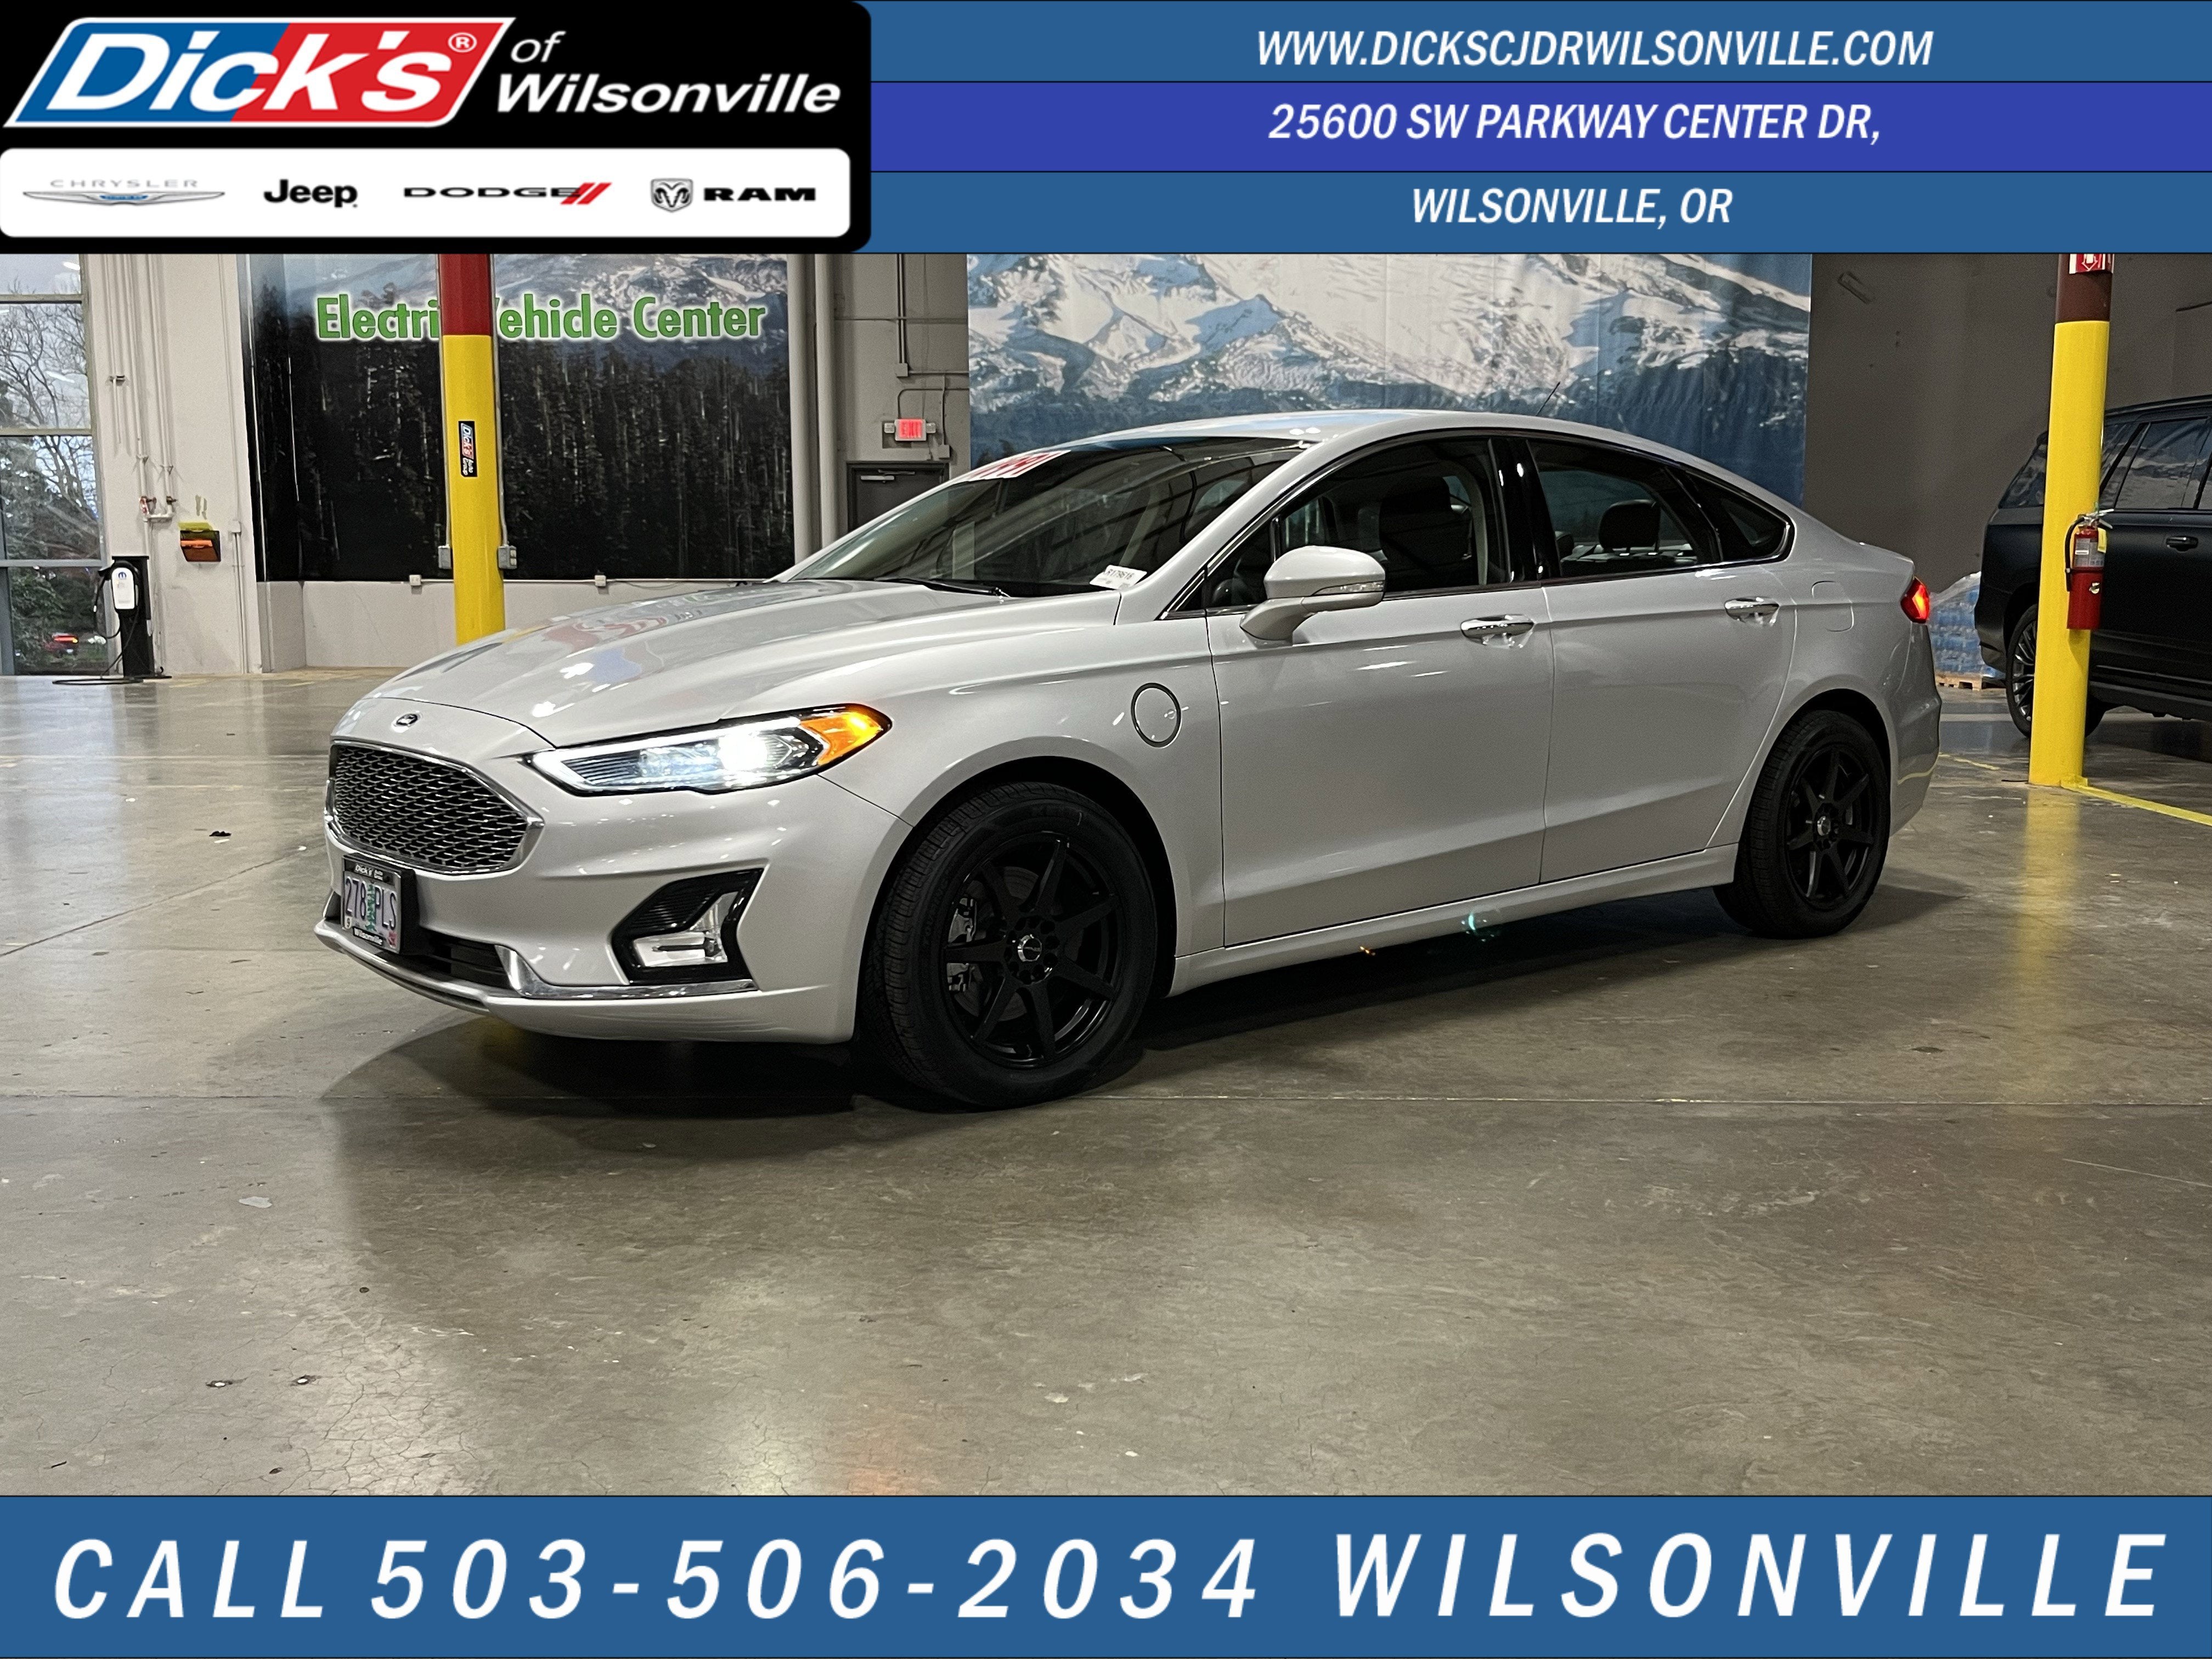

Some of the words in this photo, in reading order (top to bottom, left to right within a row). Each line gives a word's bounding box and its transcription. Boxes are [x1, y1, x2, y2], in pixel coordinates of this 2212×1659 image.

[317, 294, 438, 338] Electri
[495, 294, 617, 338] ehicle
[634, 296, 765, 338] Center
[345, 876, 366, 921] 278
[375, 884, 397, 930] PLS
